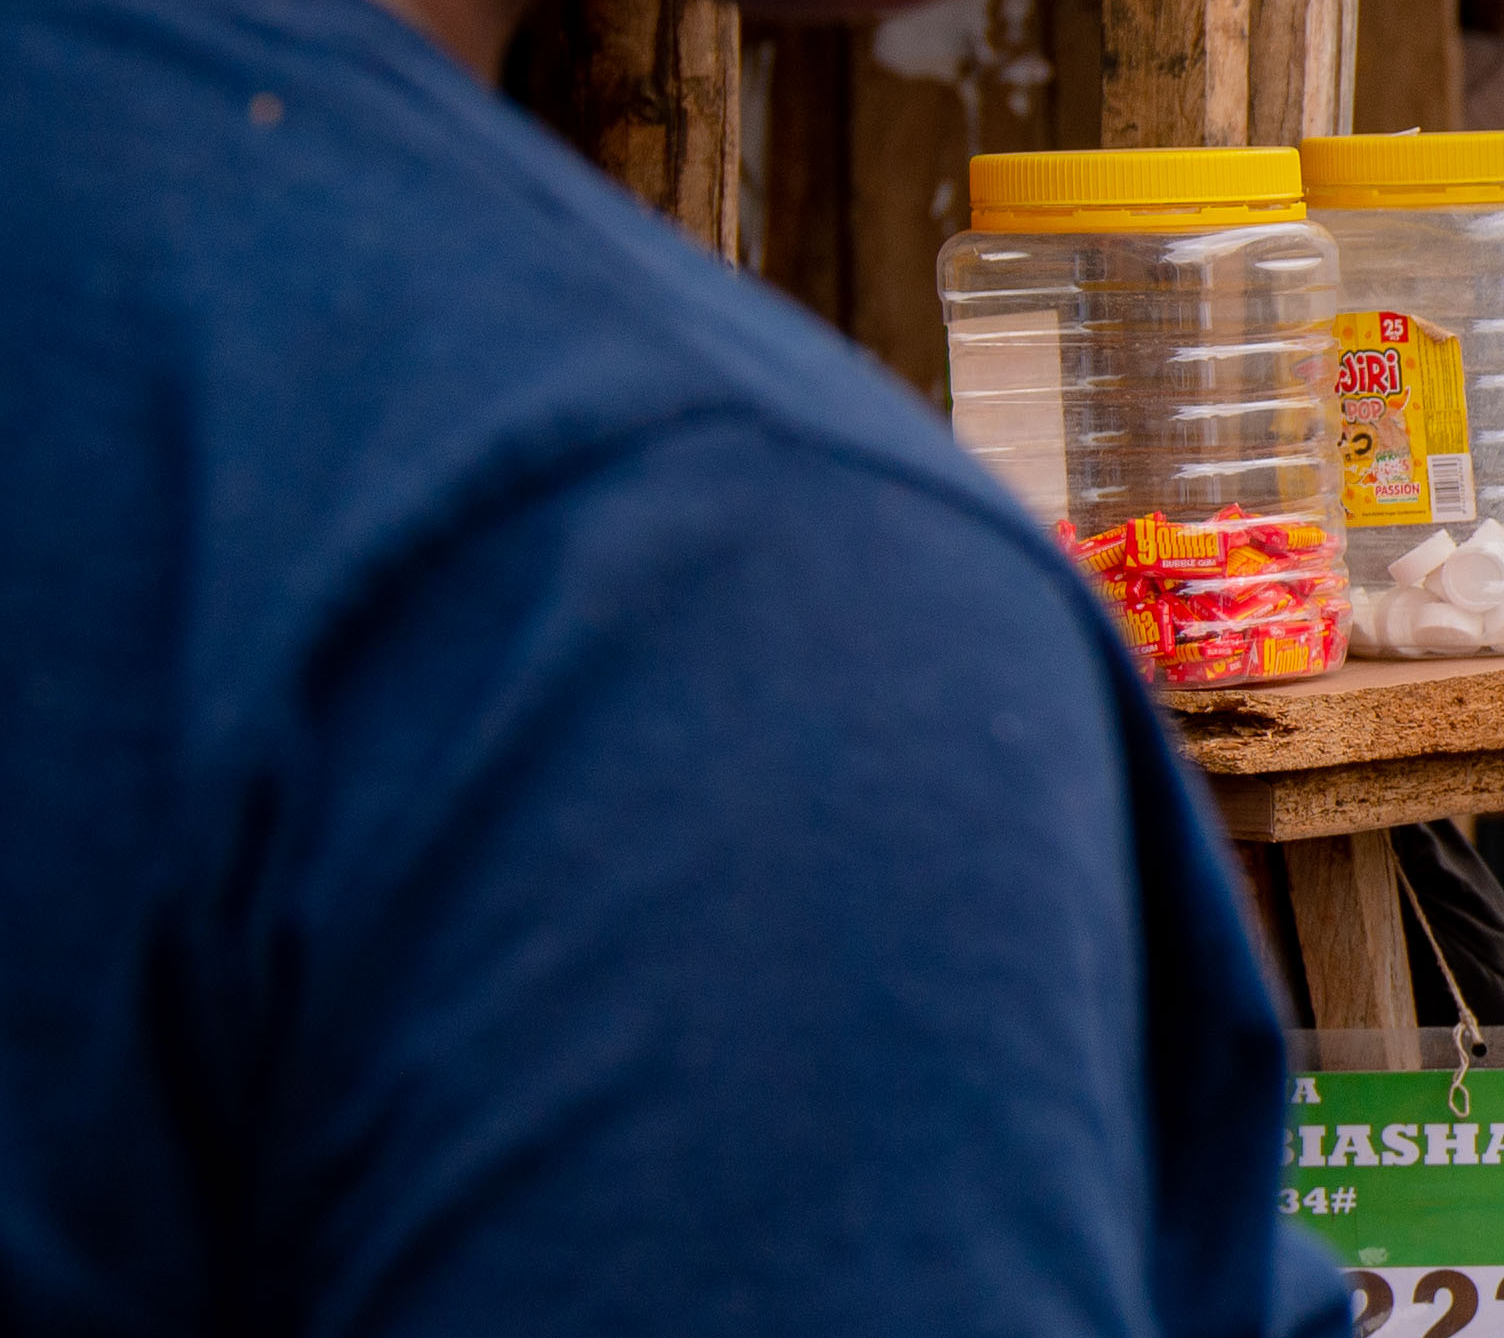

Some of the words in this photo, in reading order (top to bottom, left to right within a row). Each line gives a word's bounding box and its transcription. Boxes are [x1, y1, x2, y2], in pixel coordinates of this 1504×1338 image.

[1383, 319, 1404, 337] 25
[1344, 399, 1384, 424] POP
[1375, 483, 1420, 496] PASSION
